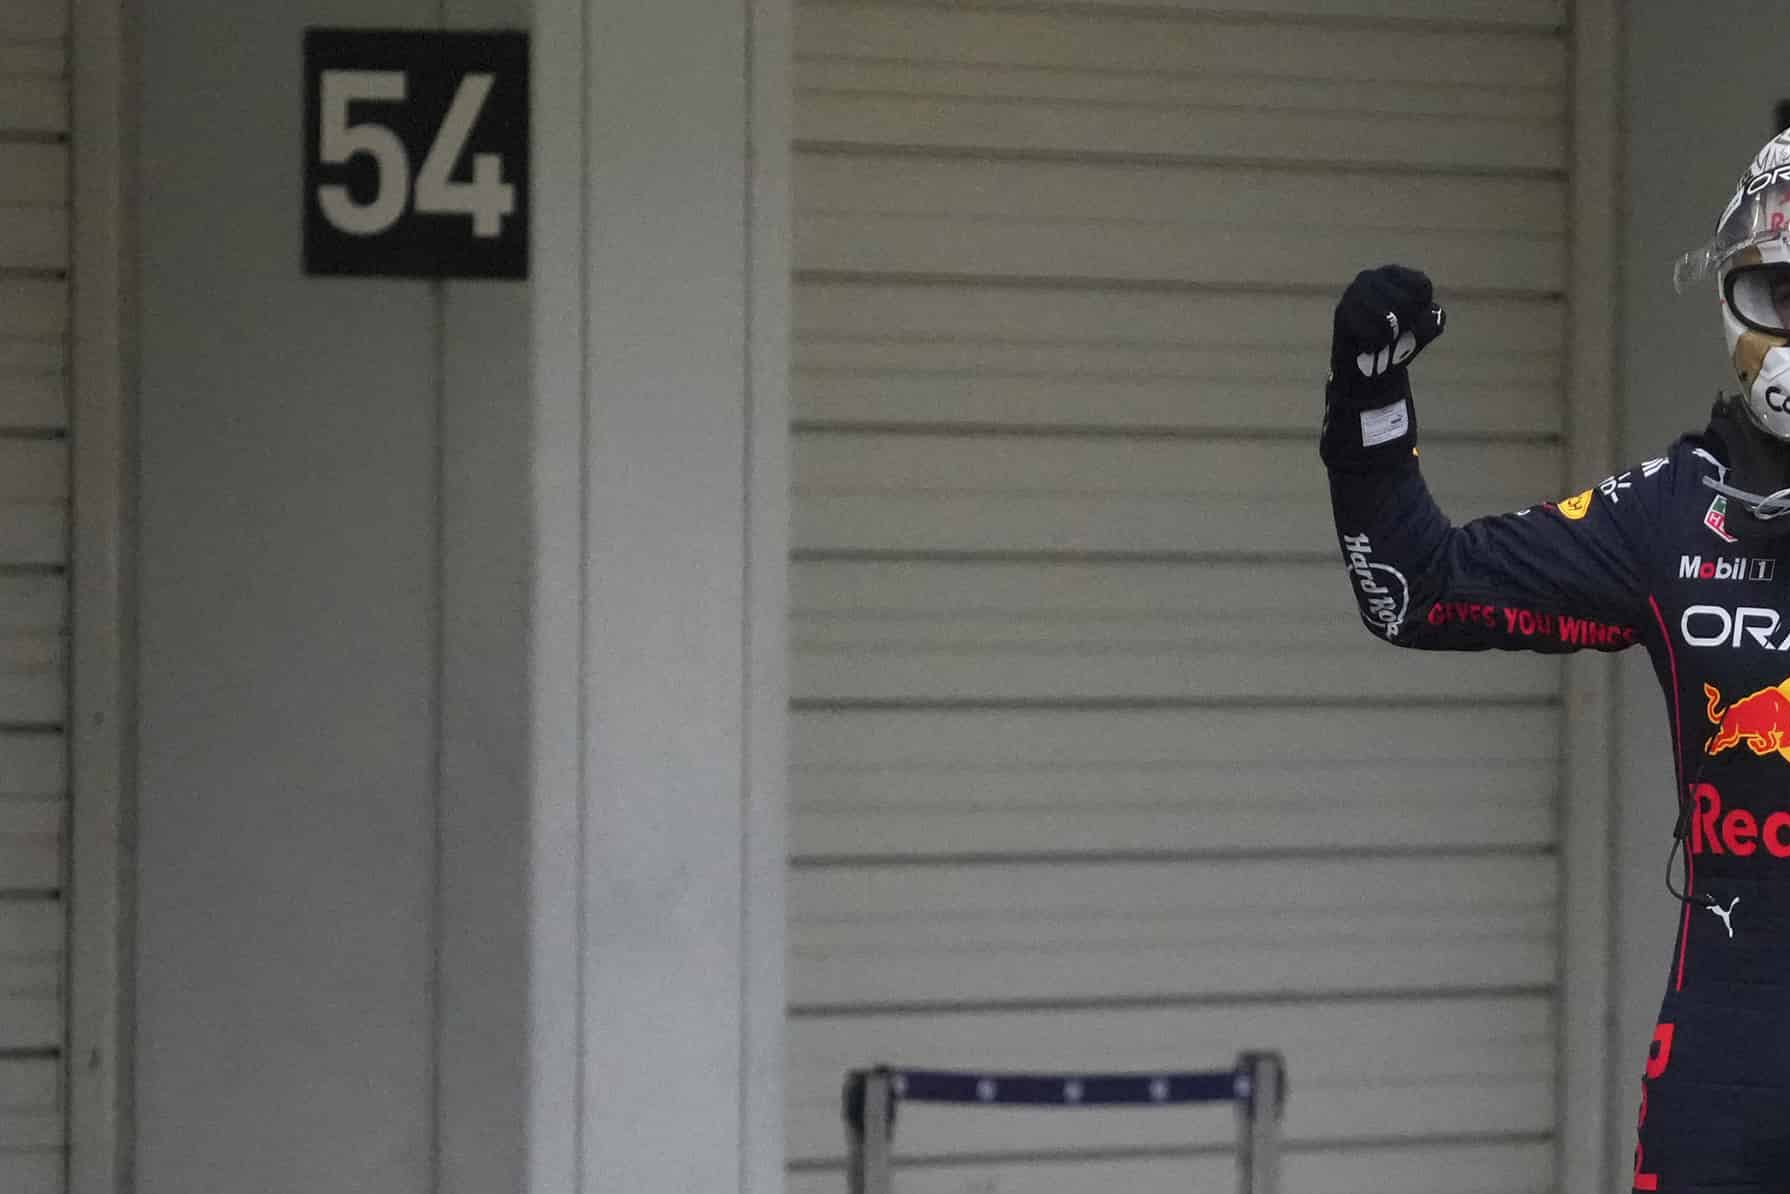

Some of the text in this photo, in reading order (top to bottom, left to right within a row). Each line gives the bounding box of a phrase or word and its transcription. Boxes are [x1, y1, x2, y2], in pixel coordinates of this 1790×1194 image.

[316, 68, 516, 237] 54
[1343, 532, 1388, 594] Hard
[1679, 555, 1747, 580] Mobil
